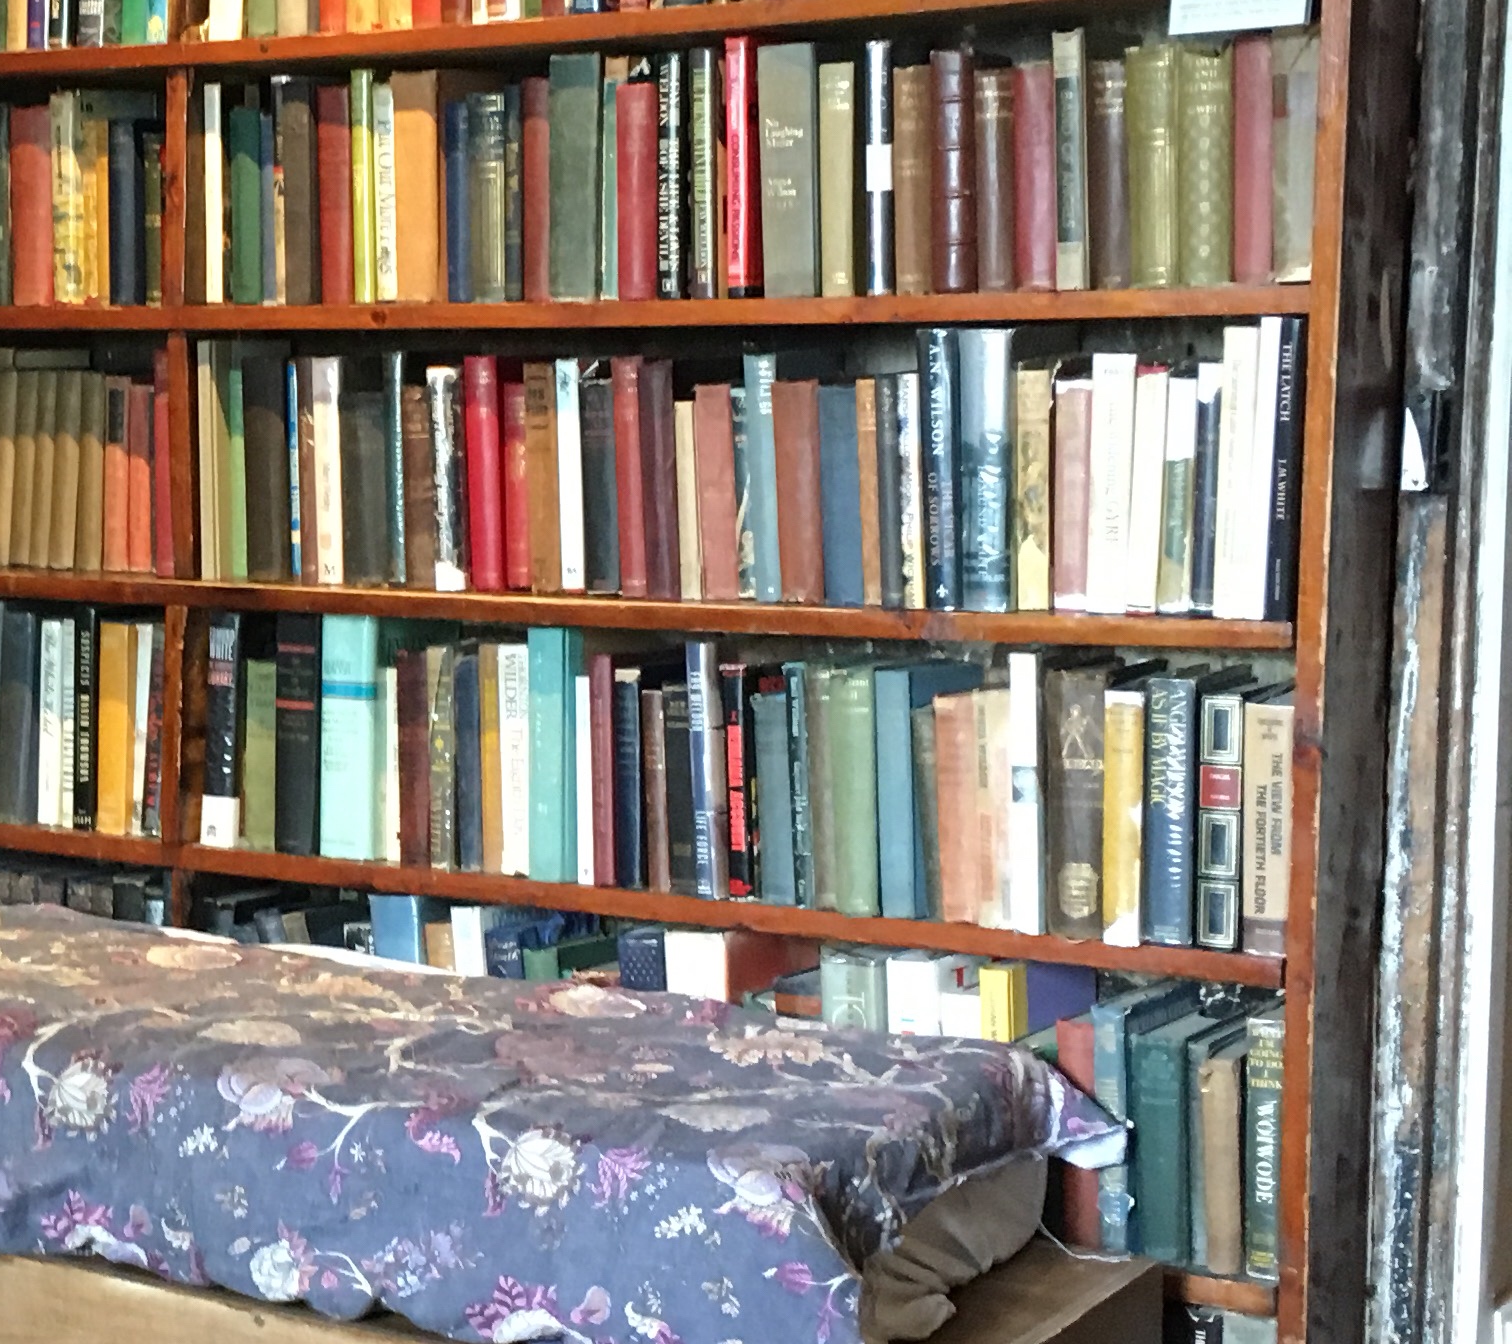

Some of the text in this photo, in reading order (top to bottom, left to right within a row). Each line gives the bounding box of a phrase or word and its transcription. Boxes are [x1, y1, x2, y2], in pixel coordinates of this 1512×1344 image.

[1277, 342, 1292, 422] THE LATCH
[928, 387, 945, 457] WILSON
[925, 472, 941, 567] OF SORROWS
[503, 653, 518, 720] WILDER
[1150, 686, 1167, 710] AS
[1150, 731, 1167, 749] BY
[1149, 756, 1167, 811] MAGIC
[1269, 752, 1284, 855] THE VIEW FROM
[694, 810, 710, 865] LIFE FORCE
[1253, 784, 1268, 915] THE FORTIETH FLOOR
[1250, 1079, 1283, 1089] THINK
[1255, 1099, 1279, 1206] WOIWODE
